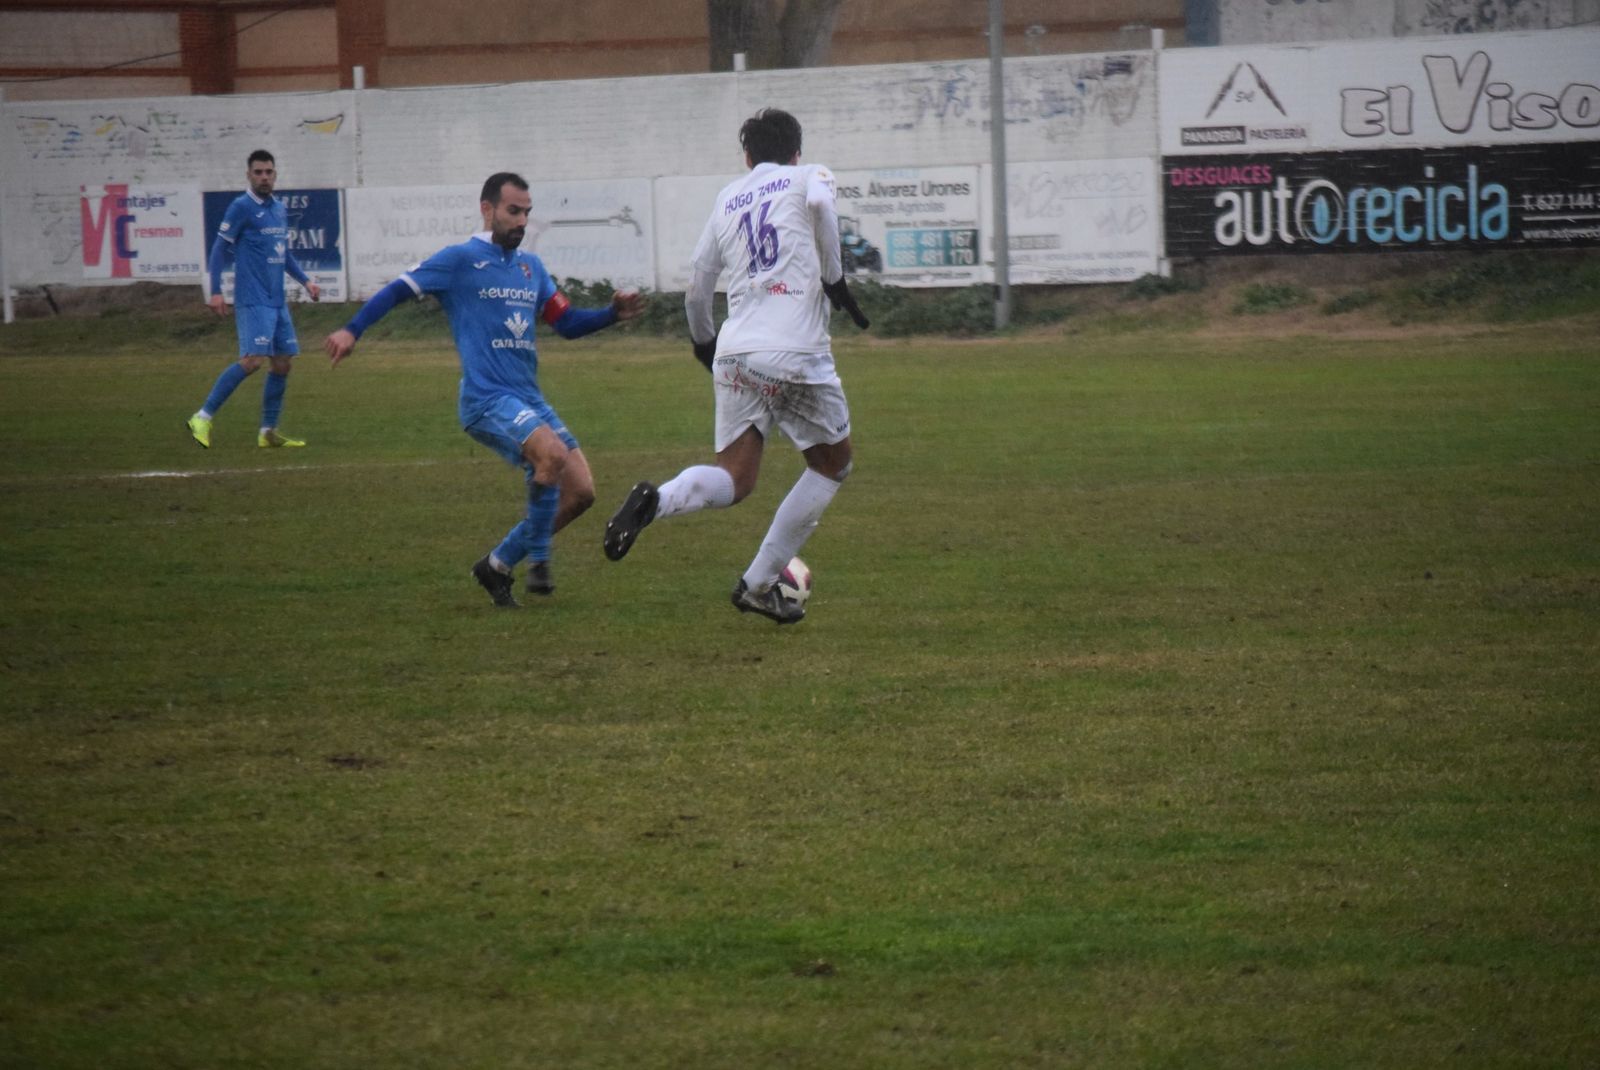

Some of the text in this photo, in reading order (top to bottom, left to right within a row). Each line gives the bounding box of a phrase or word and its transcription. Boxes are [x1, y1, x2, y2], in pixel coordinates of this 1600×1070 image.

[1340, 85, 1414, 137] El
[1170, 164, 1273, 187] DESGUACES
[836, 186, 862, 199] nos.
[921, 180, 970, 197] Urones
[724, 191, 753, 216] HUGO
[736, 200, 779, 278] 16
